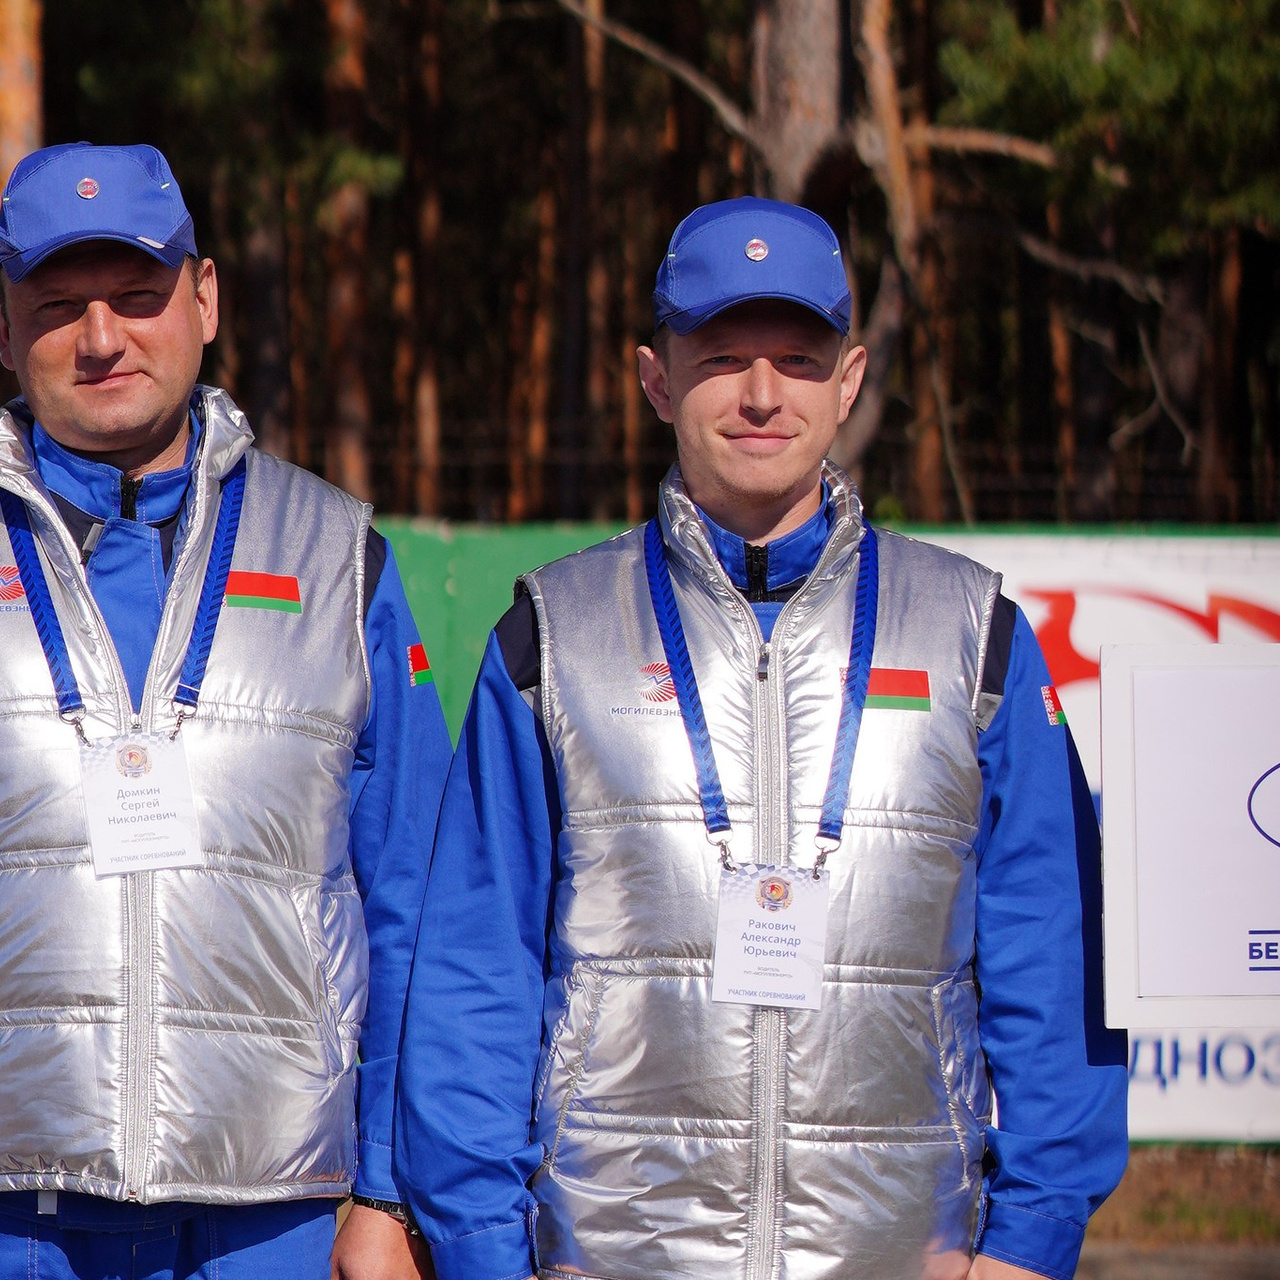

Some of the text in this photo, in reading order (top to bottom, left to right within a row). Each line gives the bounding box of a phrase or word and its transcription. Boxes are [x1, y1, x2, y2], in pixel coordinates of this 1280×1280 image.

[117, 787, 161, 800] Домкин
[121, 798, 160, 811] Сергей
[108, 811, 177, 825] Николаевич
[748, 919, 796, 931] Ракович
[741, 932, 801, 947] Александр
[743, 946, 797, 958] Юрьевич
[1248, 942, 1279, 960] БЕ
[728, 988, 806, 1000] УЧАСТНИК СОРЕВНОВАНИЙ
